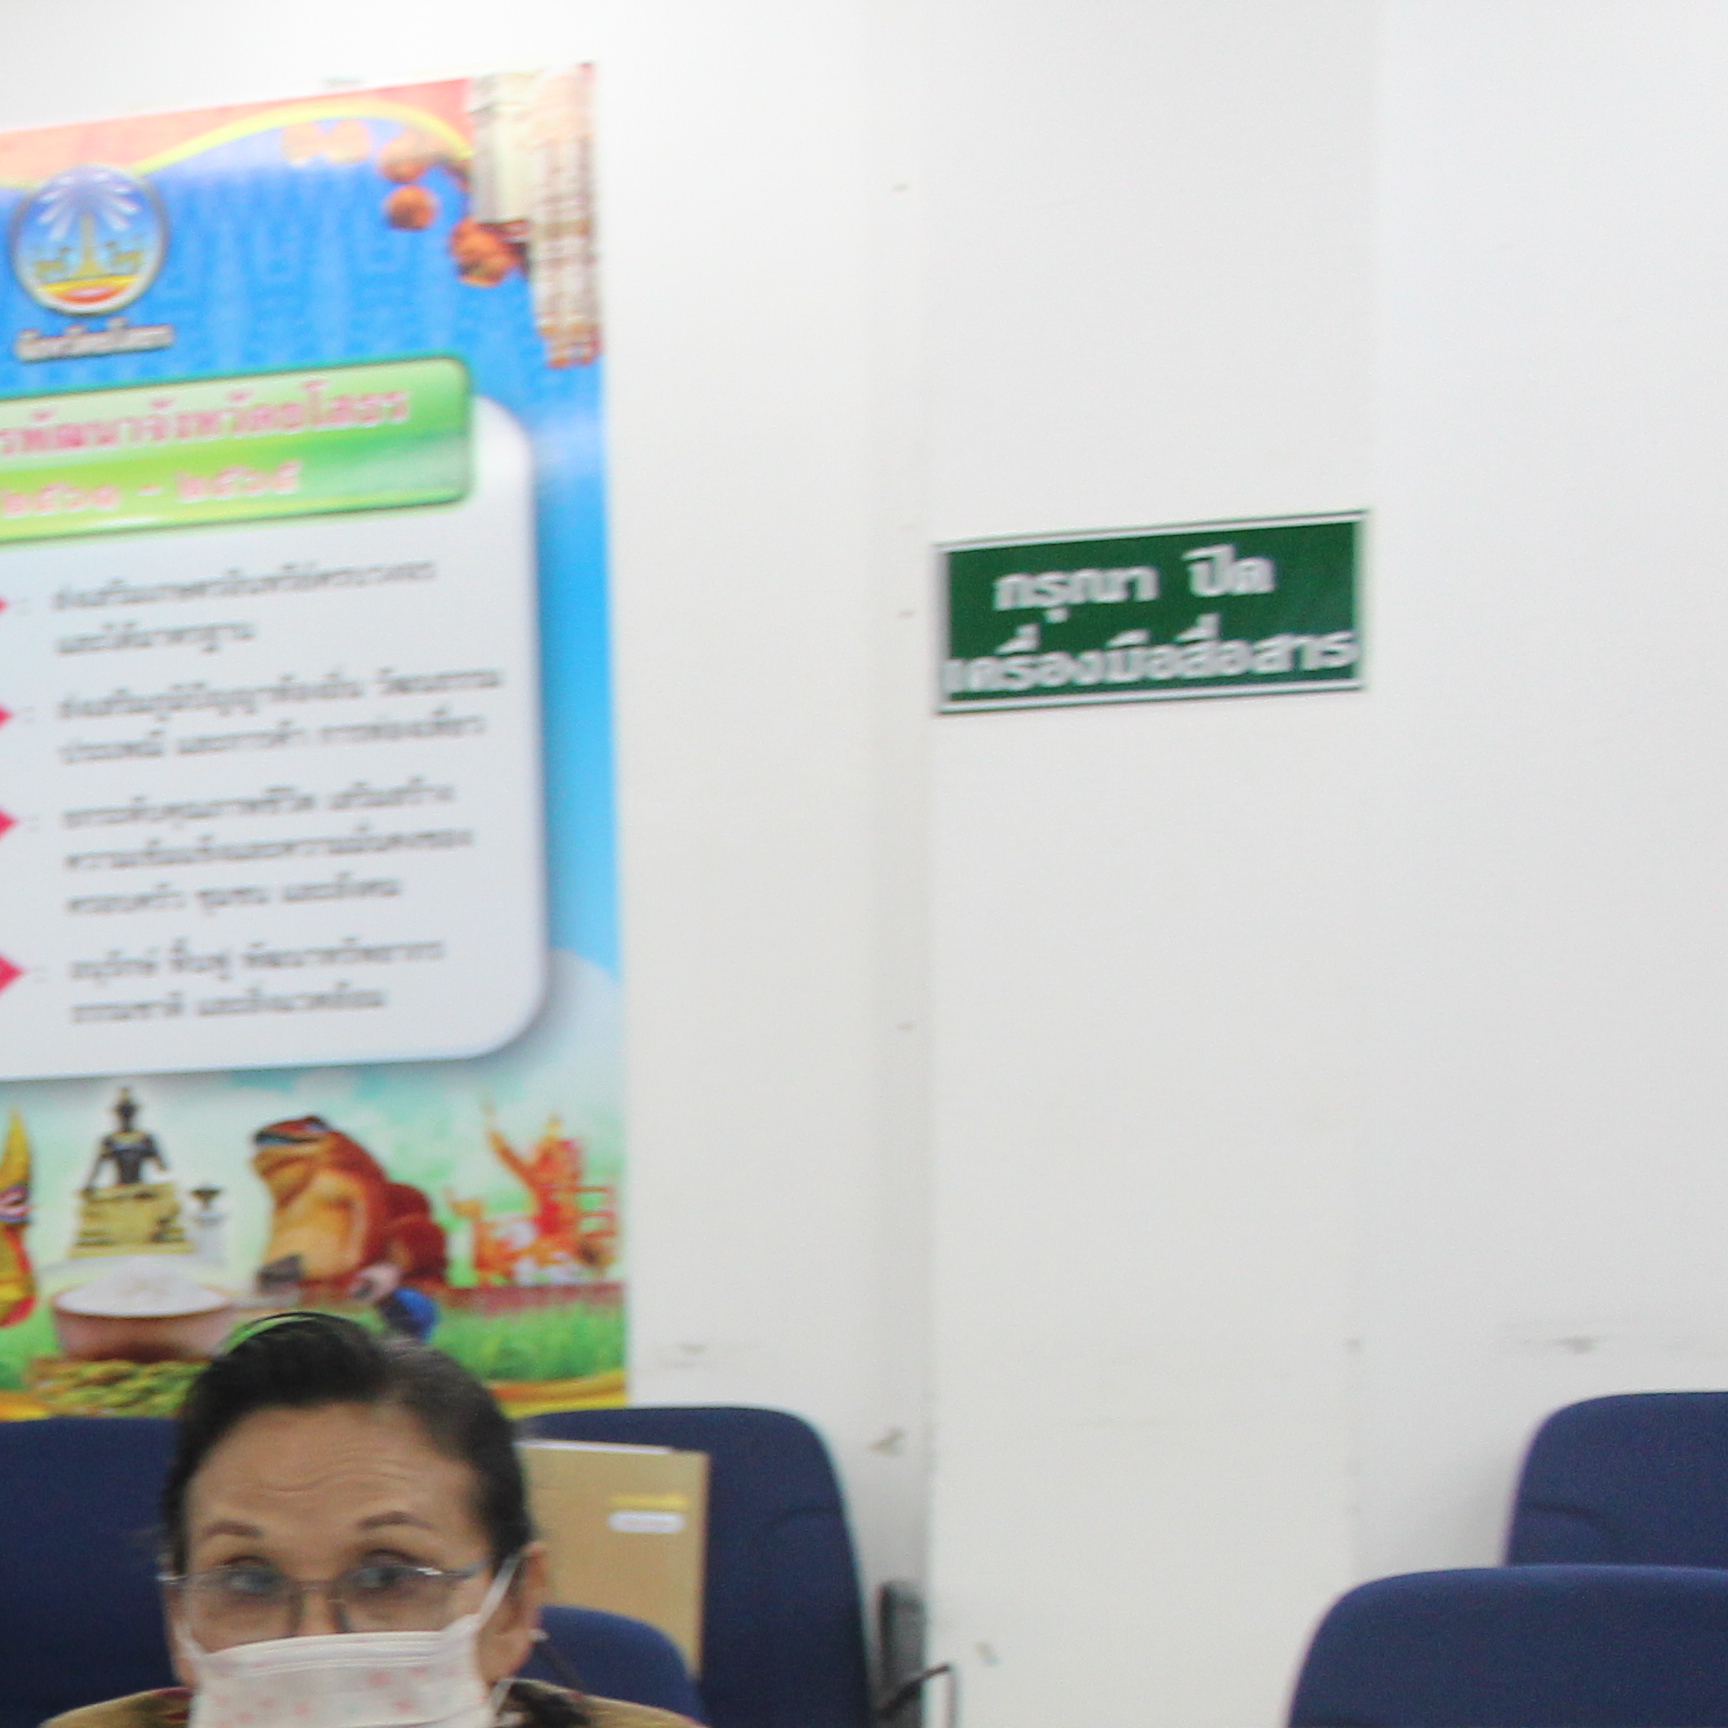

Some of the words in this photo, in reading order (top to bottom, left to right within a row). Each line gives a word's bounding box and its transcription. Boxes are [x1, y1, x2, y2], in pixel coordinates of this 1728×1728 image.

[993, 564, 1160, 623] กรุณา
[1181, 543, 1277, 598] ปิด
[944, 612, 1358, 694] เครื่องมือสื่อสาร
